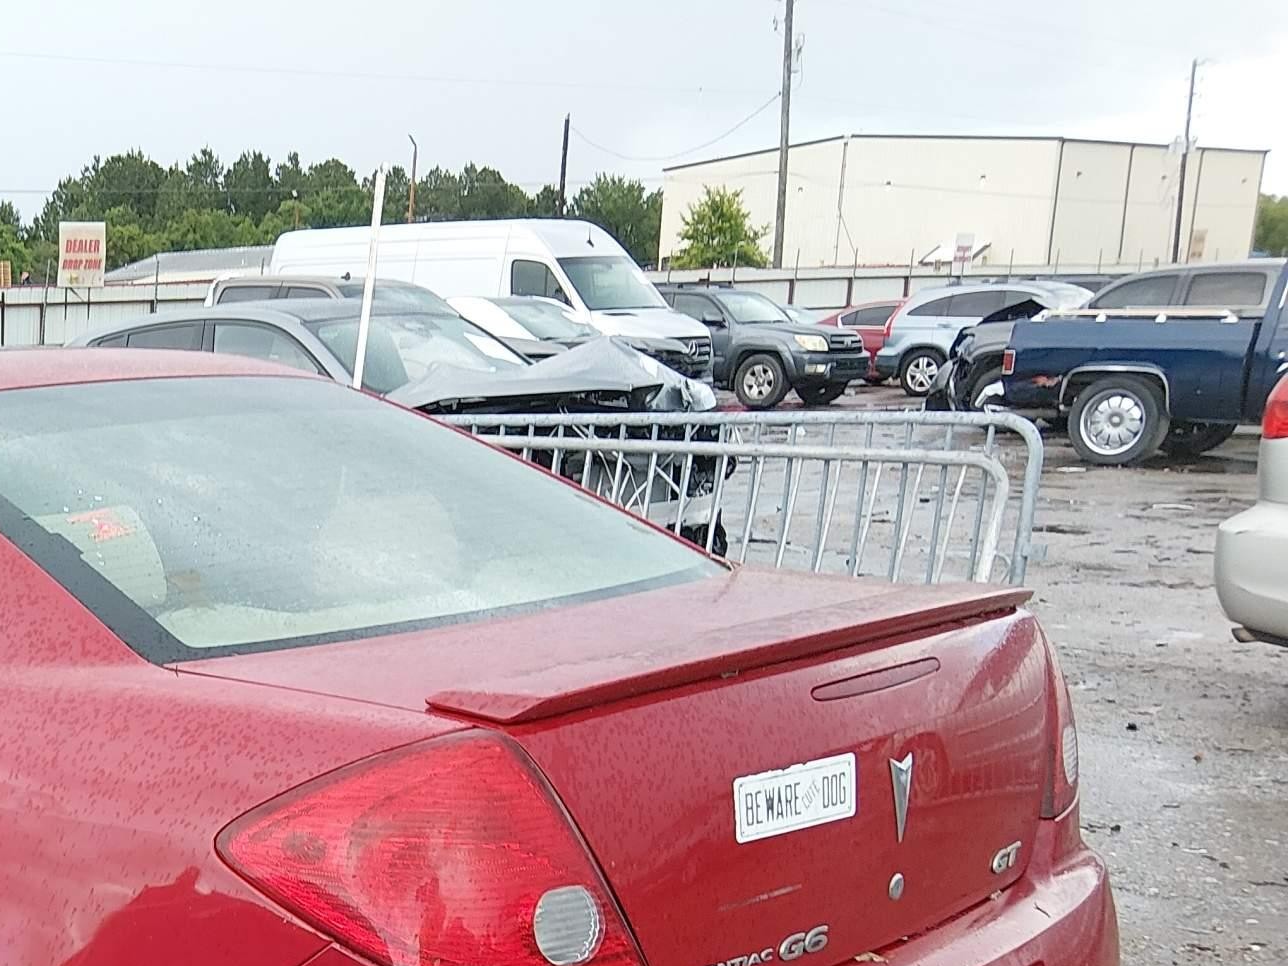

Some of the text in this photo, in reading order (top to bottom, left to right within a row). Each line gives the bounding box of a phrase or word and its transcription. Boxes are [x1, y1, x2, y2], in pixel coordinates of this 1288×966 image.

[65, 239, 101, 253] DEALER
[62, 259, 102, 270] DROP ZONE
[745, 782, 802, 826] BEWARE
[822, 772, 846, 808] DOG
[992, 840, 1022, 874] GT
[779, 924, 829, 961] G6
